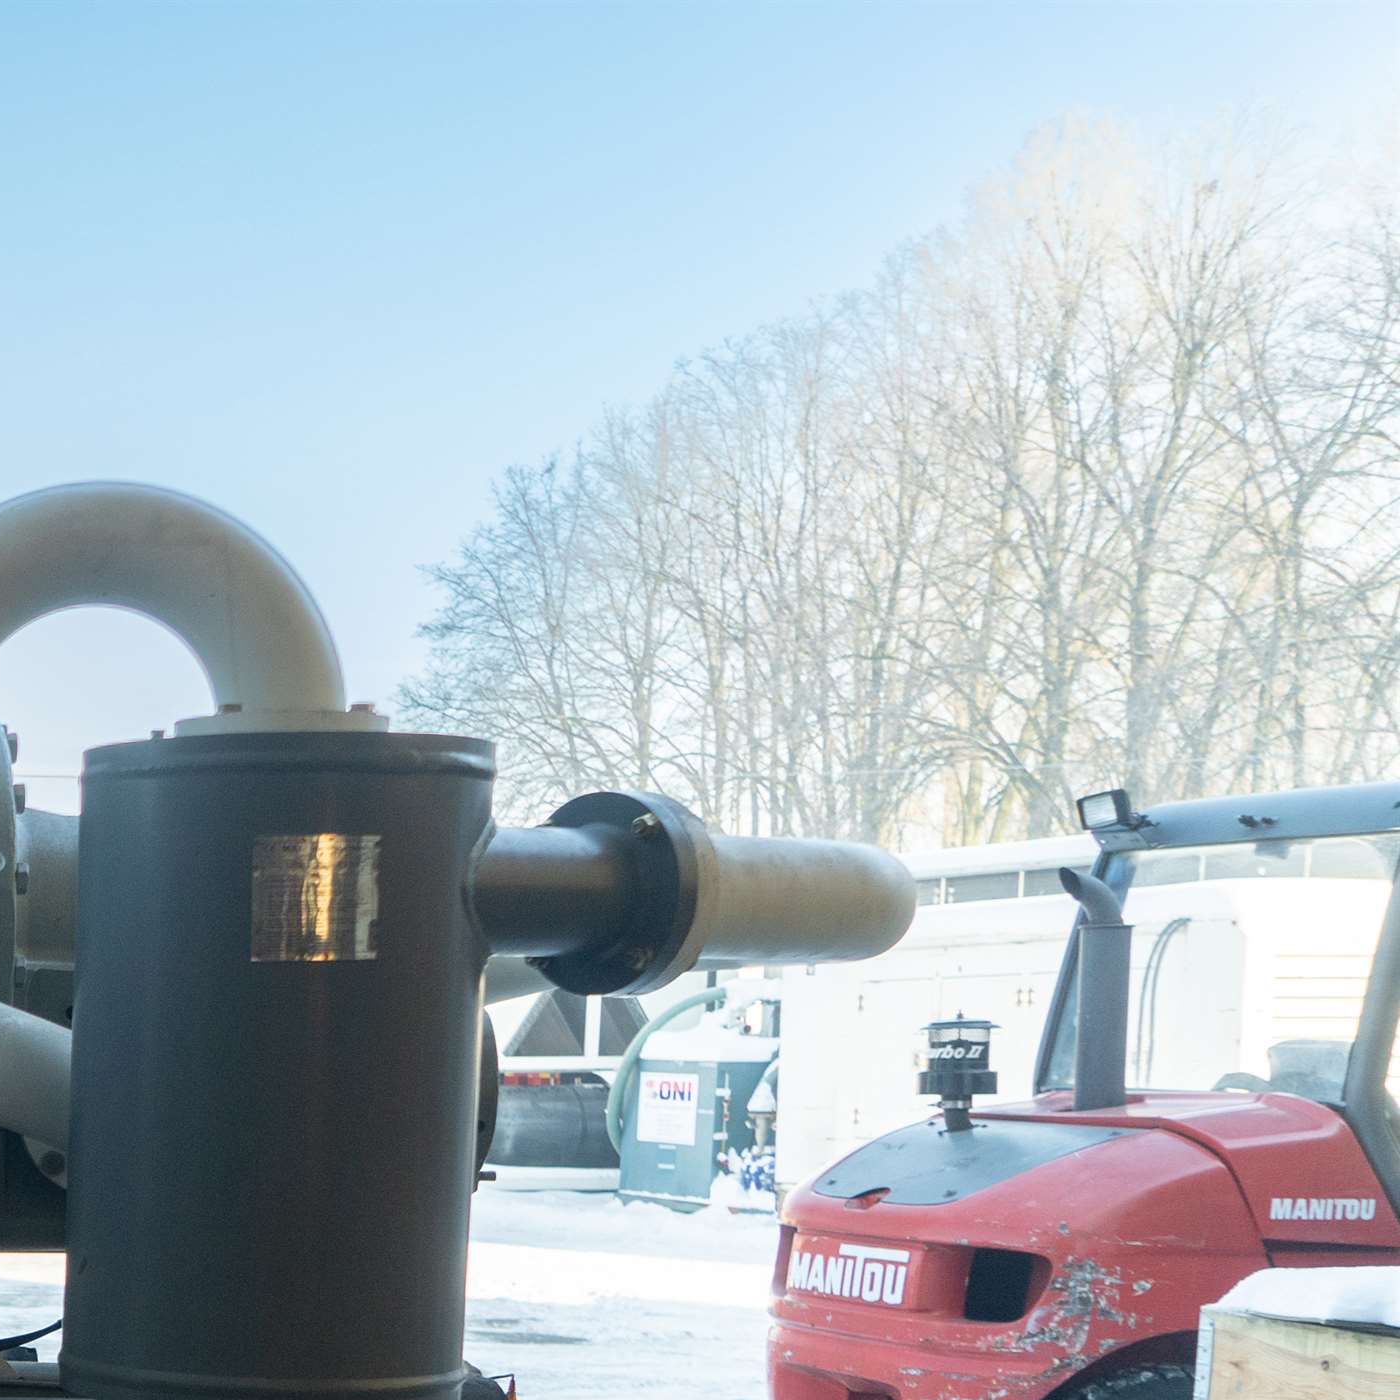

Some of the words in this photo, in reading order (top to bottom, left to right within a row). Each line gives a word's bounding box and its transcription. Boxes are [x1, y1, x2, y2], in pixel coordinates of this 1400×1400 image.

[659, 1081, 692, 1101] ONI
[1270, 1198, 1376, 1220] MANITOU
[789, 1243, 910, 1305] MANITOU
